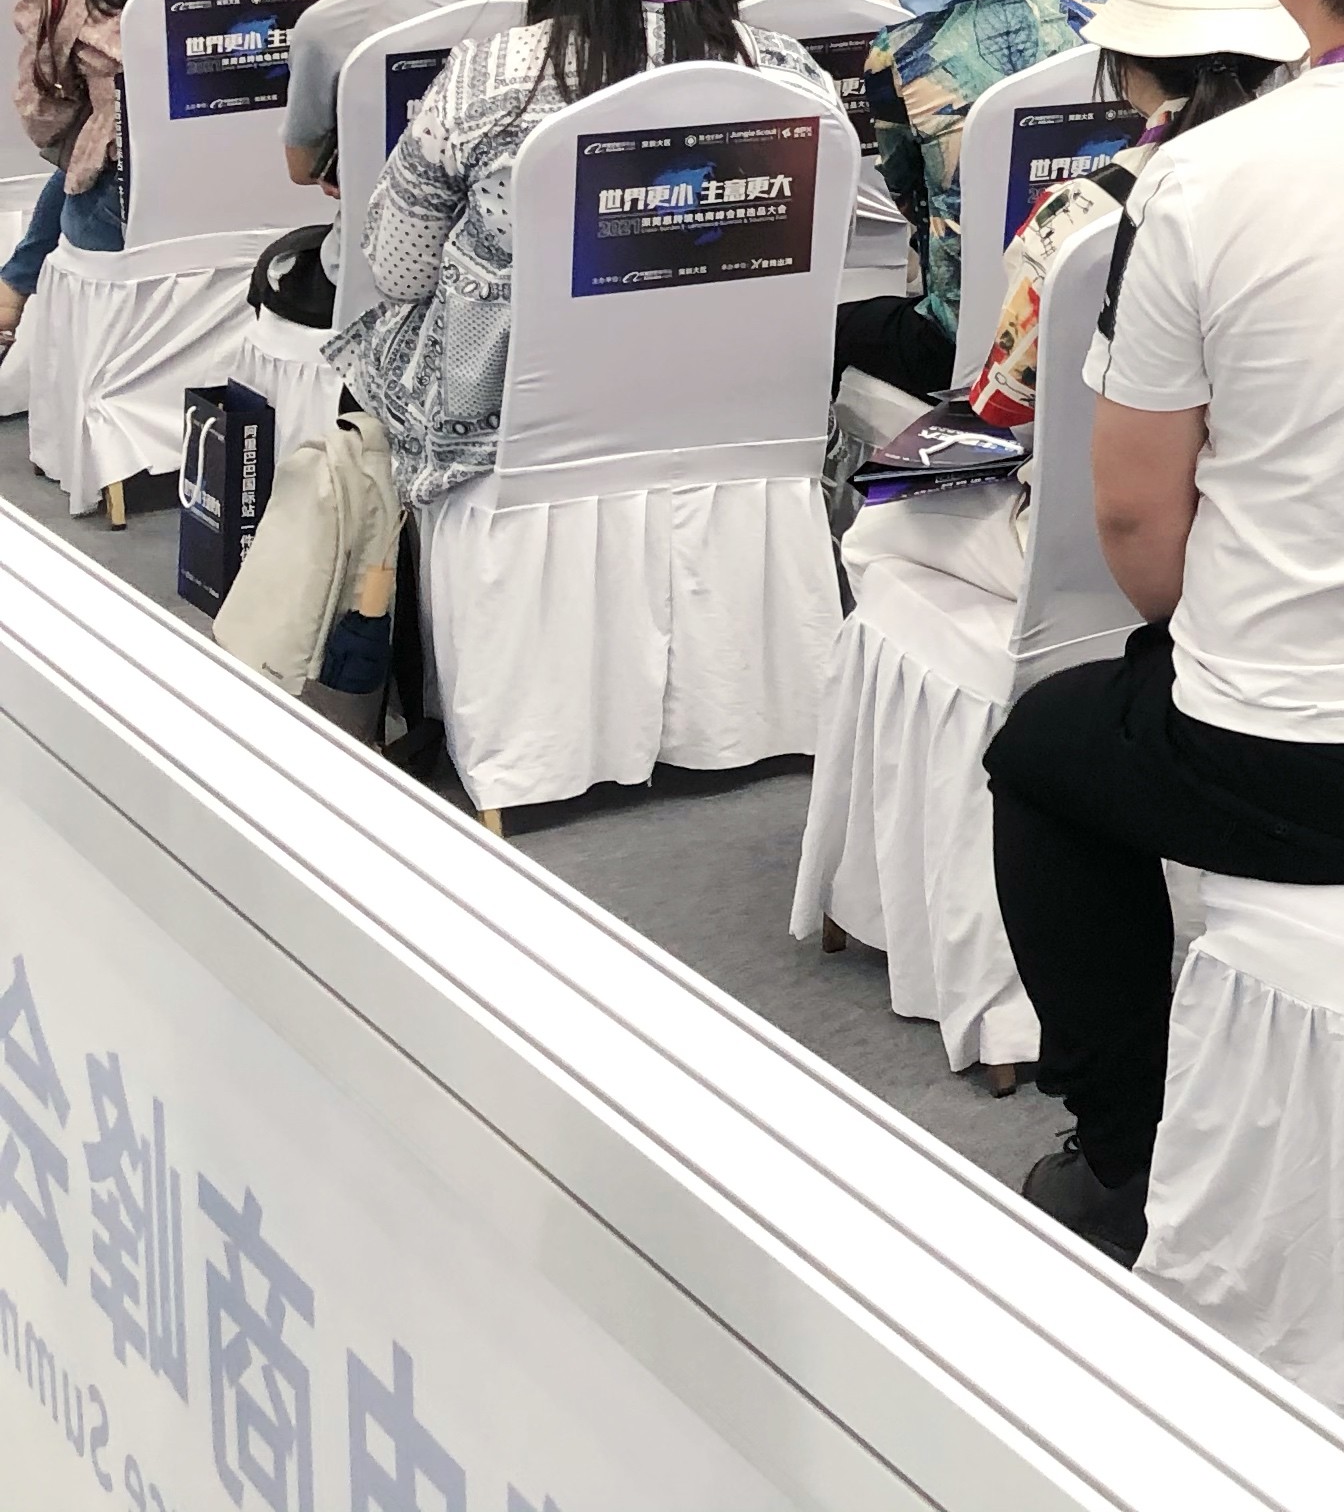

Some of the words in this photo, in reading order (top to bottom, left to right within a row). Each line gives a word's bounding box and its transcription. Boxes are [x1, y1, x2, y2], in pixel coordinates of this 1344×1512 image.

[186, 31, 263, 57] 世界更小
[598, 183, 694, 214] 世界更小
[700, 174, 793, 204] 生意更大
[240, 424, 258, 518] 阿里巴巴国际站
